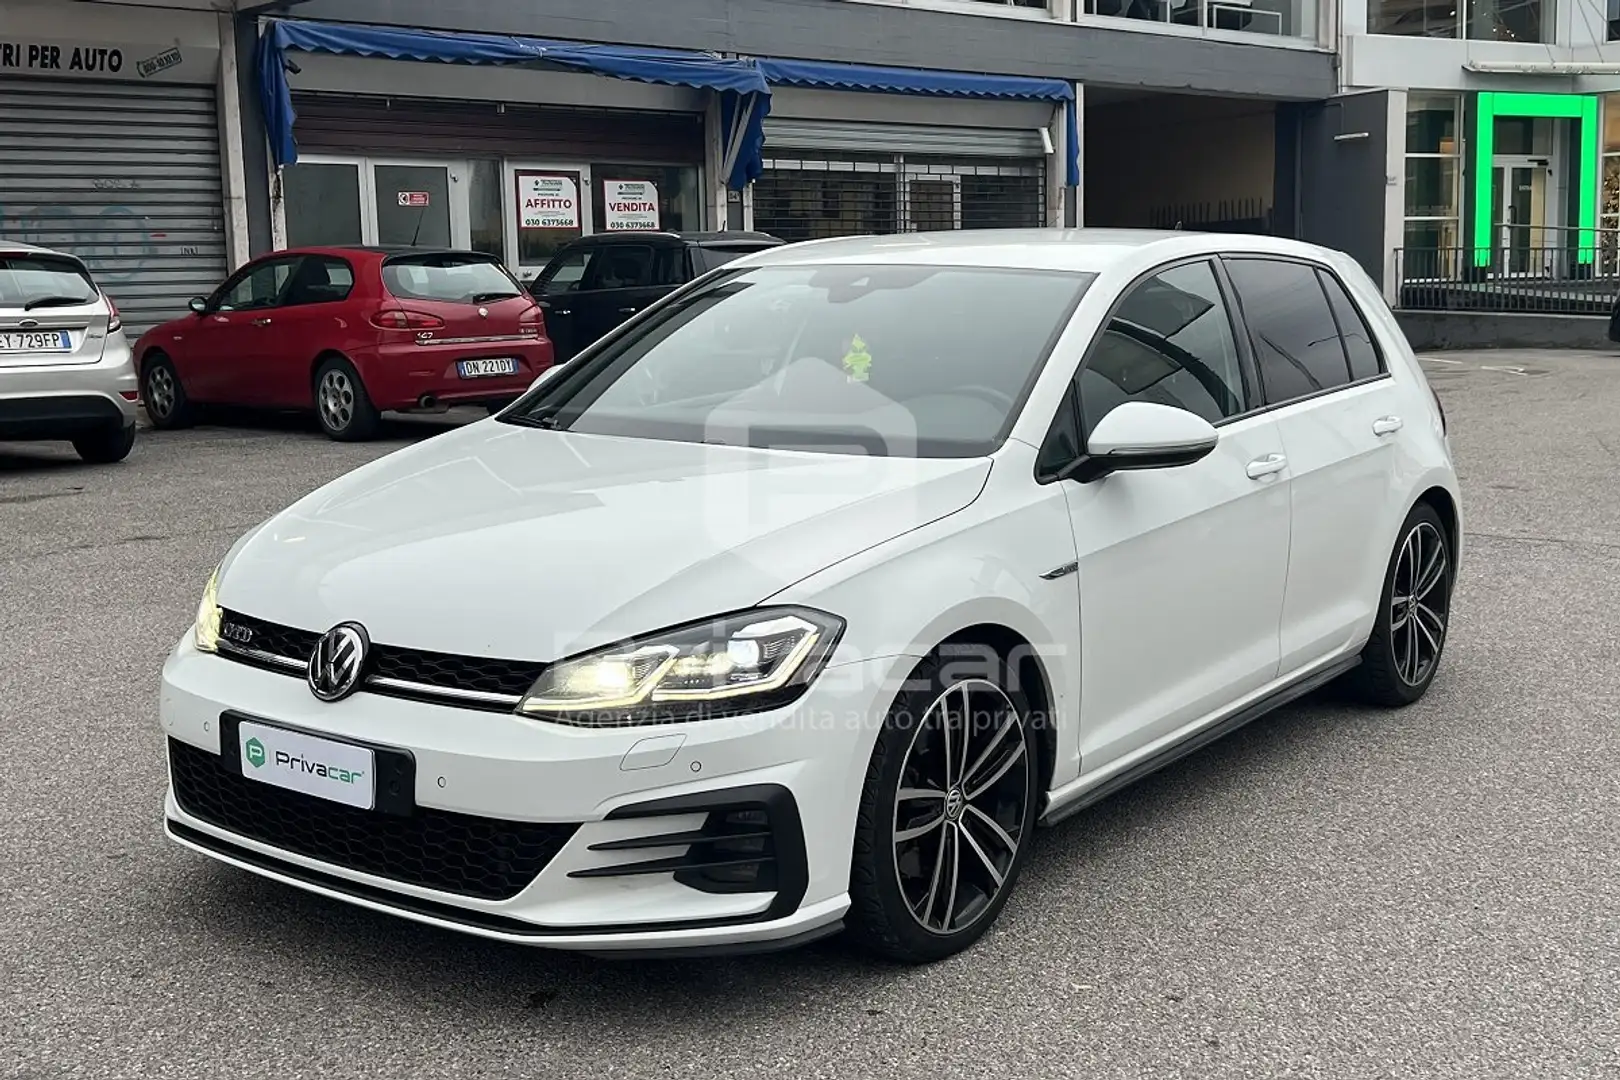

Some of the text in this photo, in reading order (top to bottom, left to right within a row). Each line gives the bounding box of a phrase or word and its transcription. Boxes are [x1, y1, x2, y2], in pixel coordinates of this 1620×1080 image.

[0, 43, 20, 66] RI
[28, 44, 60, 69] PER
[69, 47, 123, 72] AUTO
[525, 198, 572, 209] AFFITTO
[608, 202, 655, 211] VENDITA
[525, 218, 540, 226] 030
[16, 333, 60, 348] 729FP
[465, 361, 481, 374] DN
[275, 750, 361, 783] Privacar
